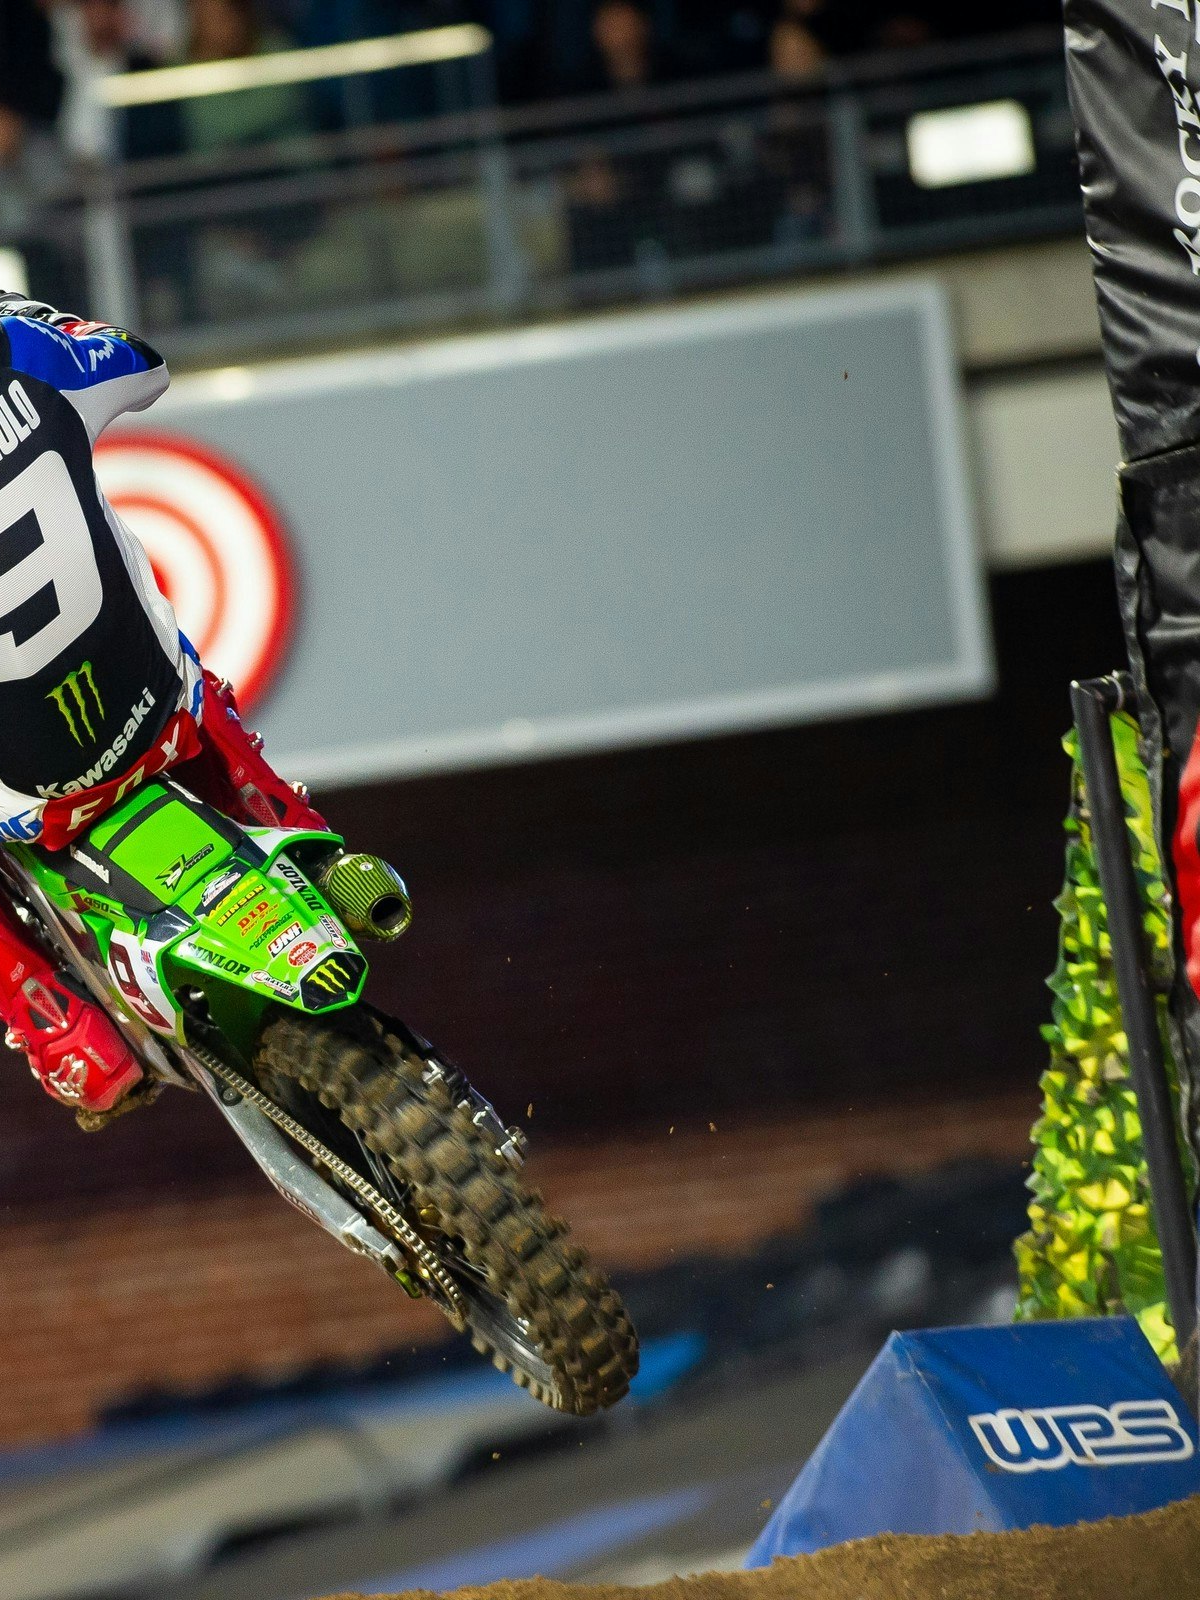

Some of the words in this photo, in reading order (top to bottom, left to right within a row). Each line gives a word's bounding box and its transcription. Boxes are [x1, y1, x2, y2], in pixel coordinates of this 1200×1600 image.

[35, 686, 157, 800] Kawasaki
[217, 883, 266, 926] HINSON
[275, 862, 325, 912] DUNLOP
[187, 941, 252, 976] DUNLOP
[269, 923, 302, 956] UNI
[968, 1399, 1195, 1474] WPS
